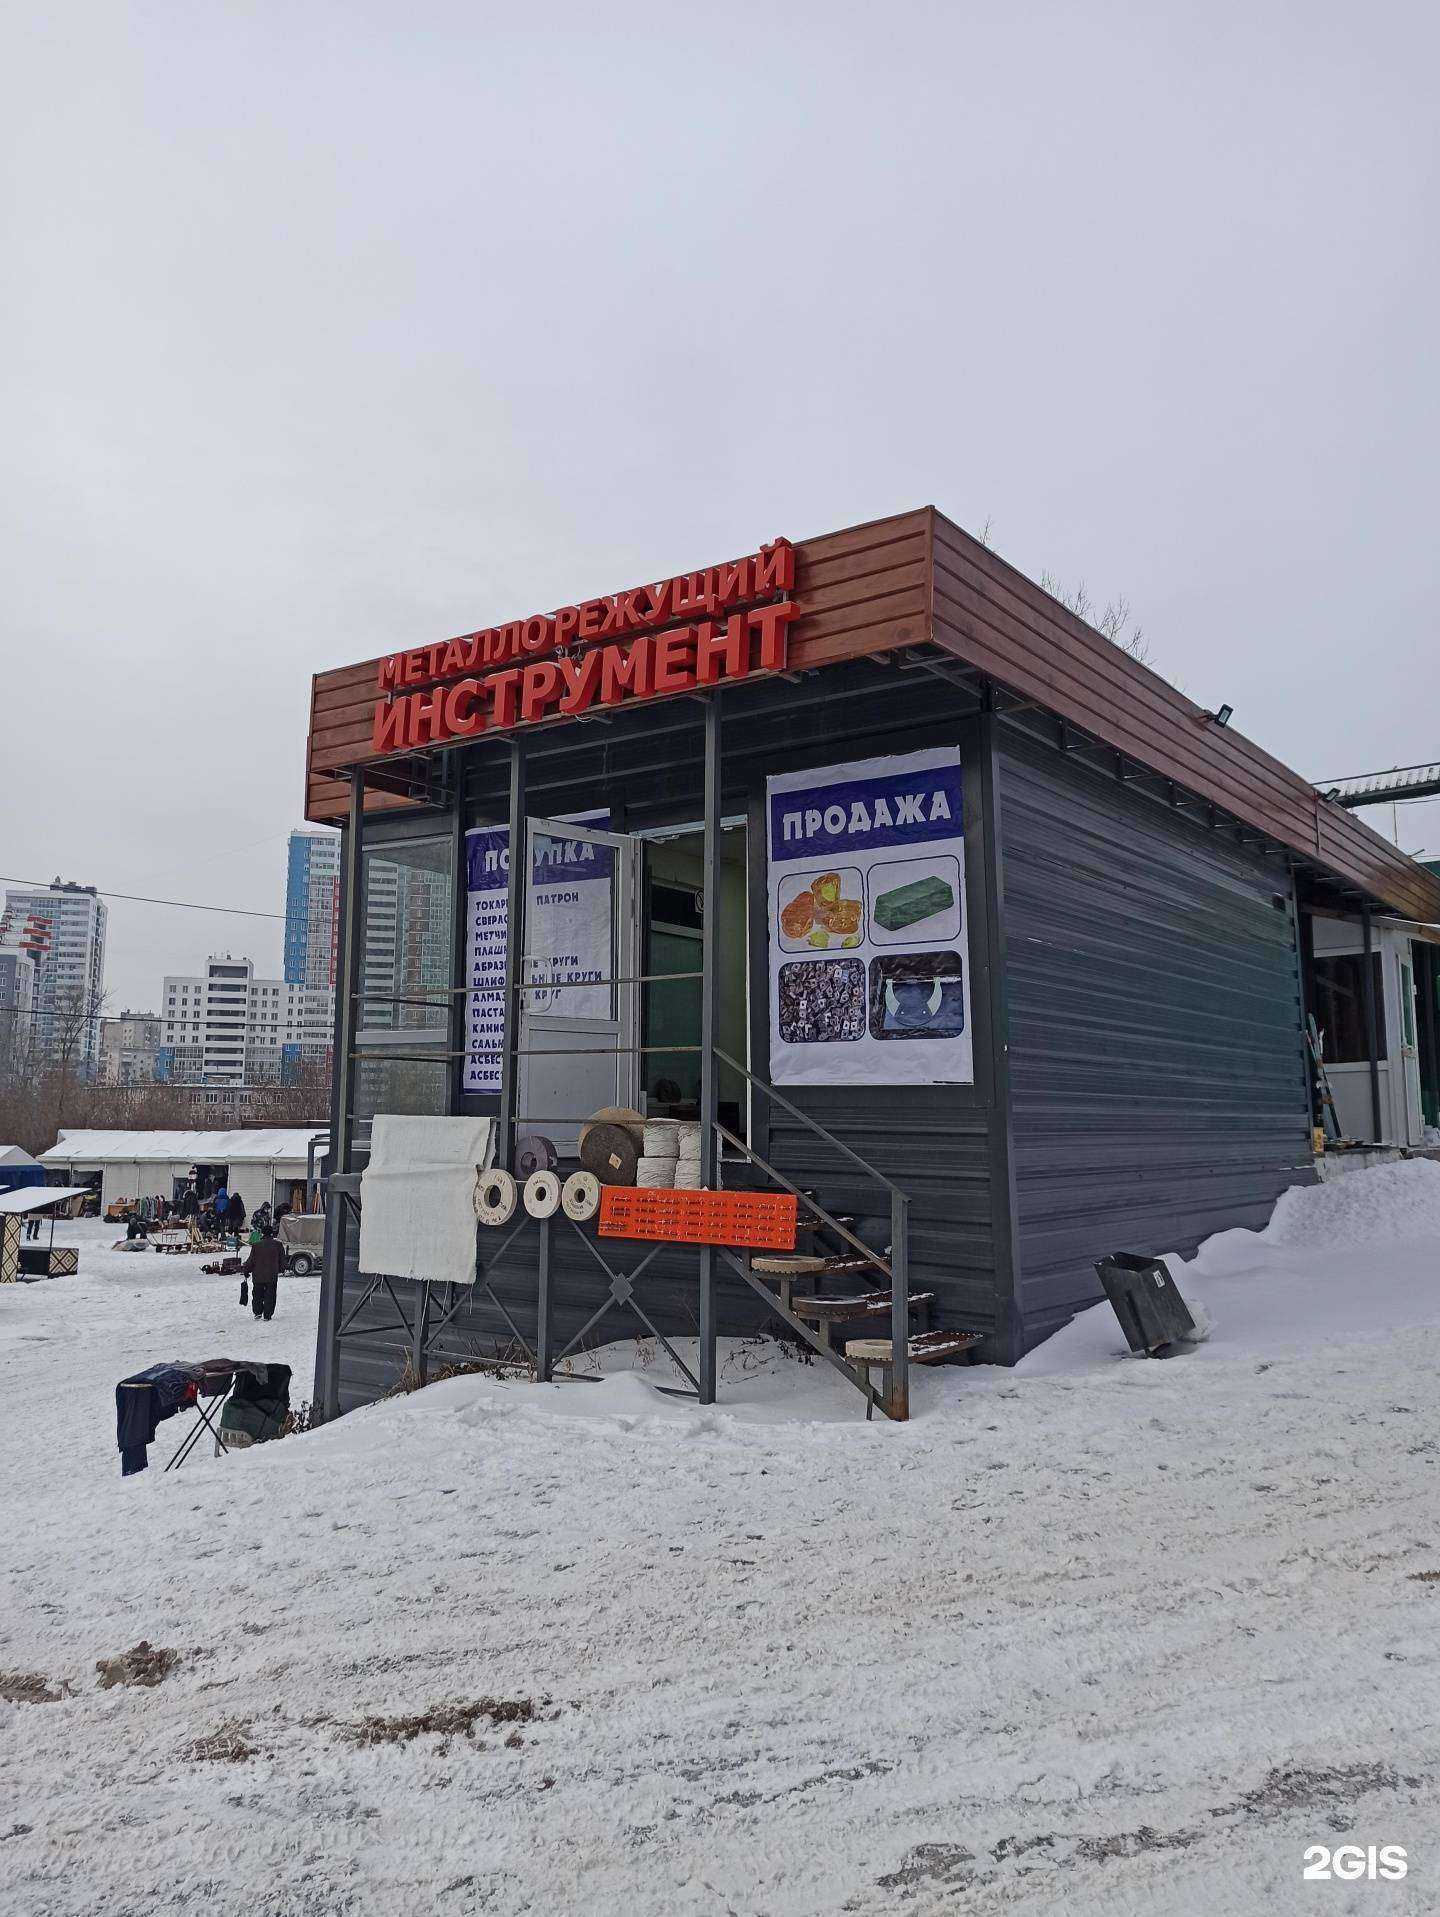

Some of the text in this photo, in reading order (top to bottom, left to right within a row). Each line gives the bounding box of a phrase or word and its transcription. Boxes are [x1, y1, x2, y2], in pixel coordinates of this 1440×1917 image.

[378, 536, 796, 690] МЕТАЛЛОРЕЖУЩИЙ
[373, 601, 799, 753] ИНСТРУМЕНТ
[783, 791, 951, 841] ПРОДАЖА
[485, 840, 595, 872] ПОУПКА
[475, 892, 579, 911] ТОКАР ПАТРОН
[475, 930, 507, 941] МЕТЧИ
[567, 970, 602, 983] КРУГИ
[470, 1054, 504, 1065] АСБЕС
[469, 1070, 503, 1080] АСБЕС
